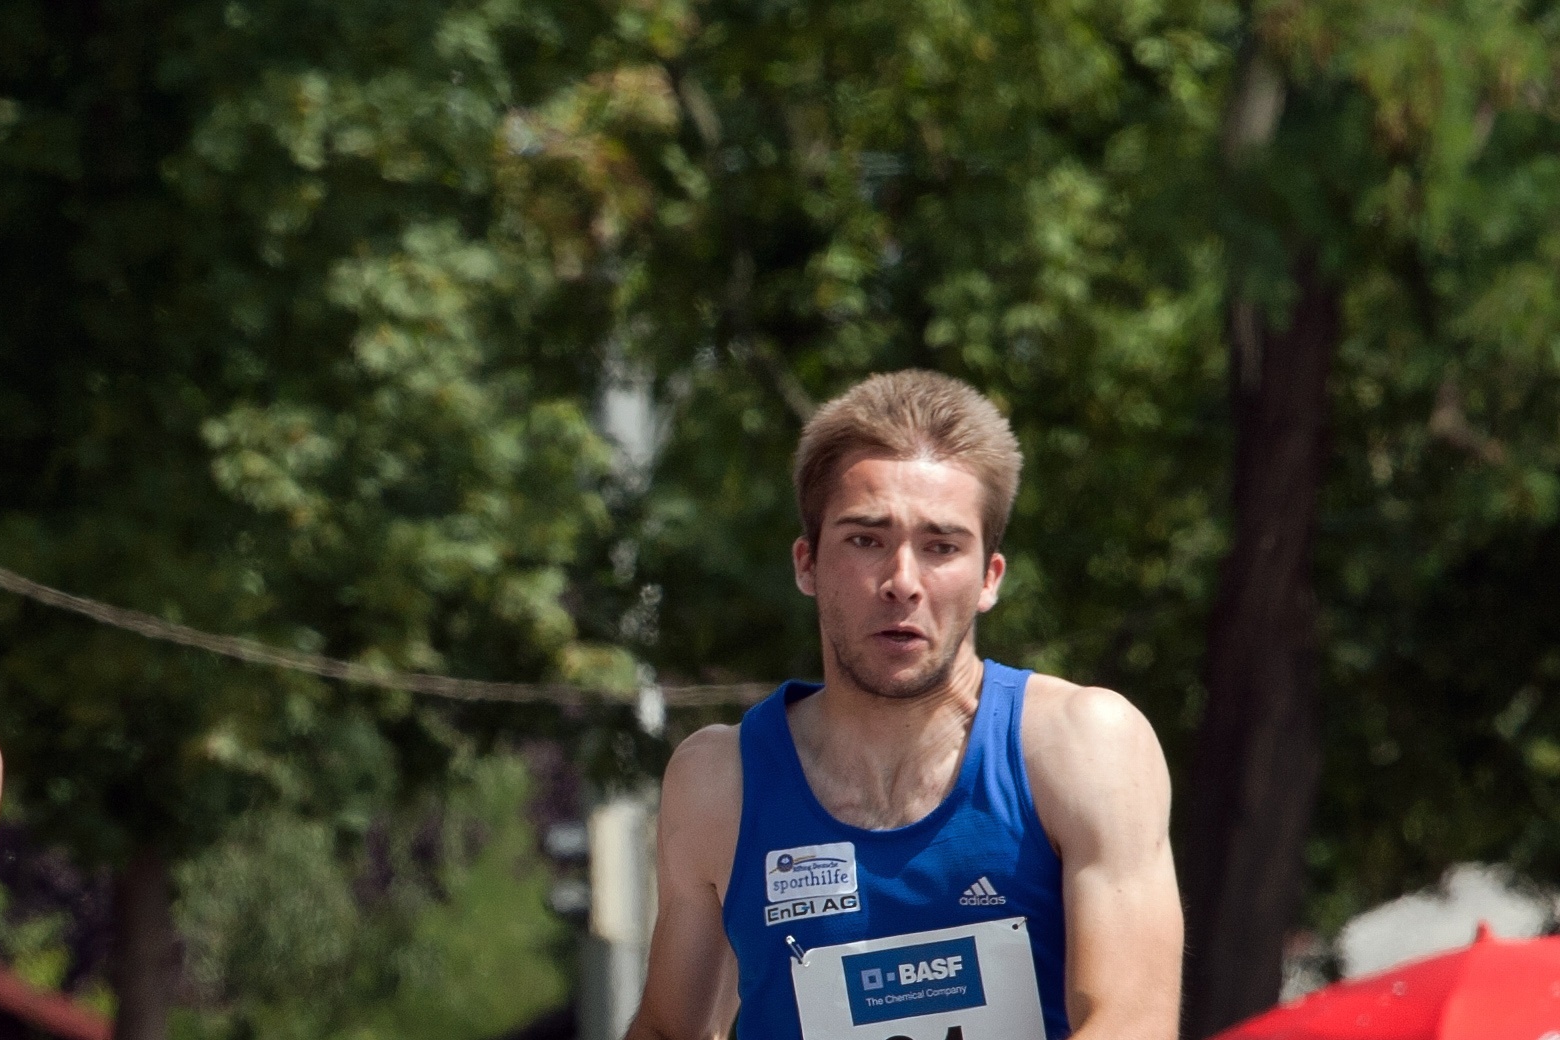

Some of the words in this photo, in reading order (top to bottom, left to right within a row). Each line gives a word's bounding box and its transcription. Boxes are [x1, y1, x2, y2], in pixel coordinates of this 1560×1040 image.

[773, 869, 849, 894] sporthilfe
[822, 895, 857, 913] AG
[959, 895, 1006, 906] adidas
[898, 955, 963, 985] BASF
[865, 997, 884, 1007] The
[884, 990, 925, 1004] Chemical
[926, 985, 967, 998] Company
